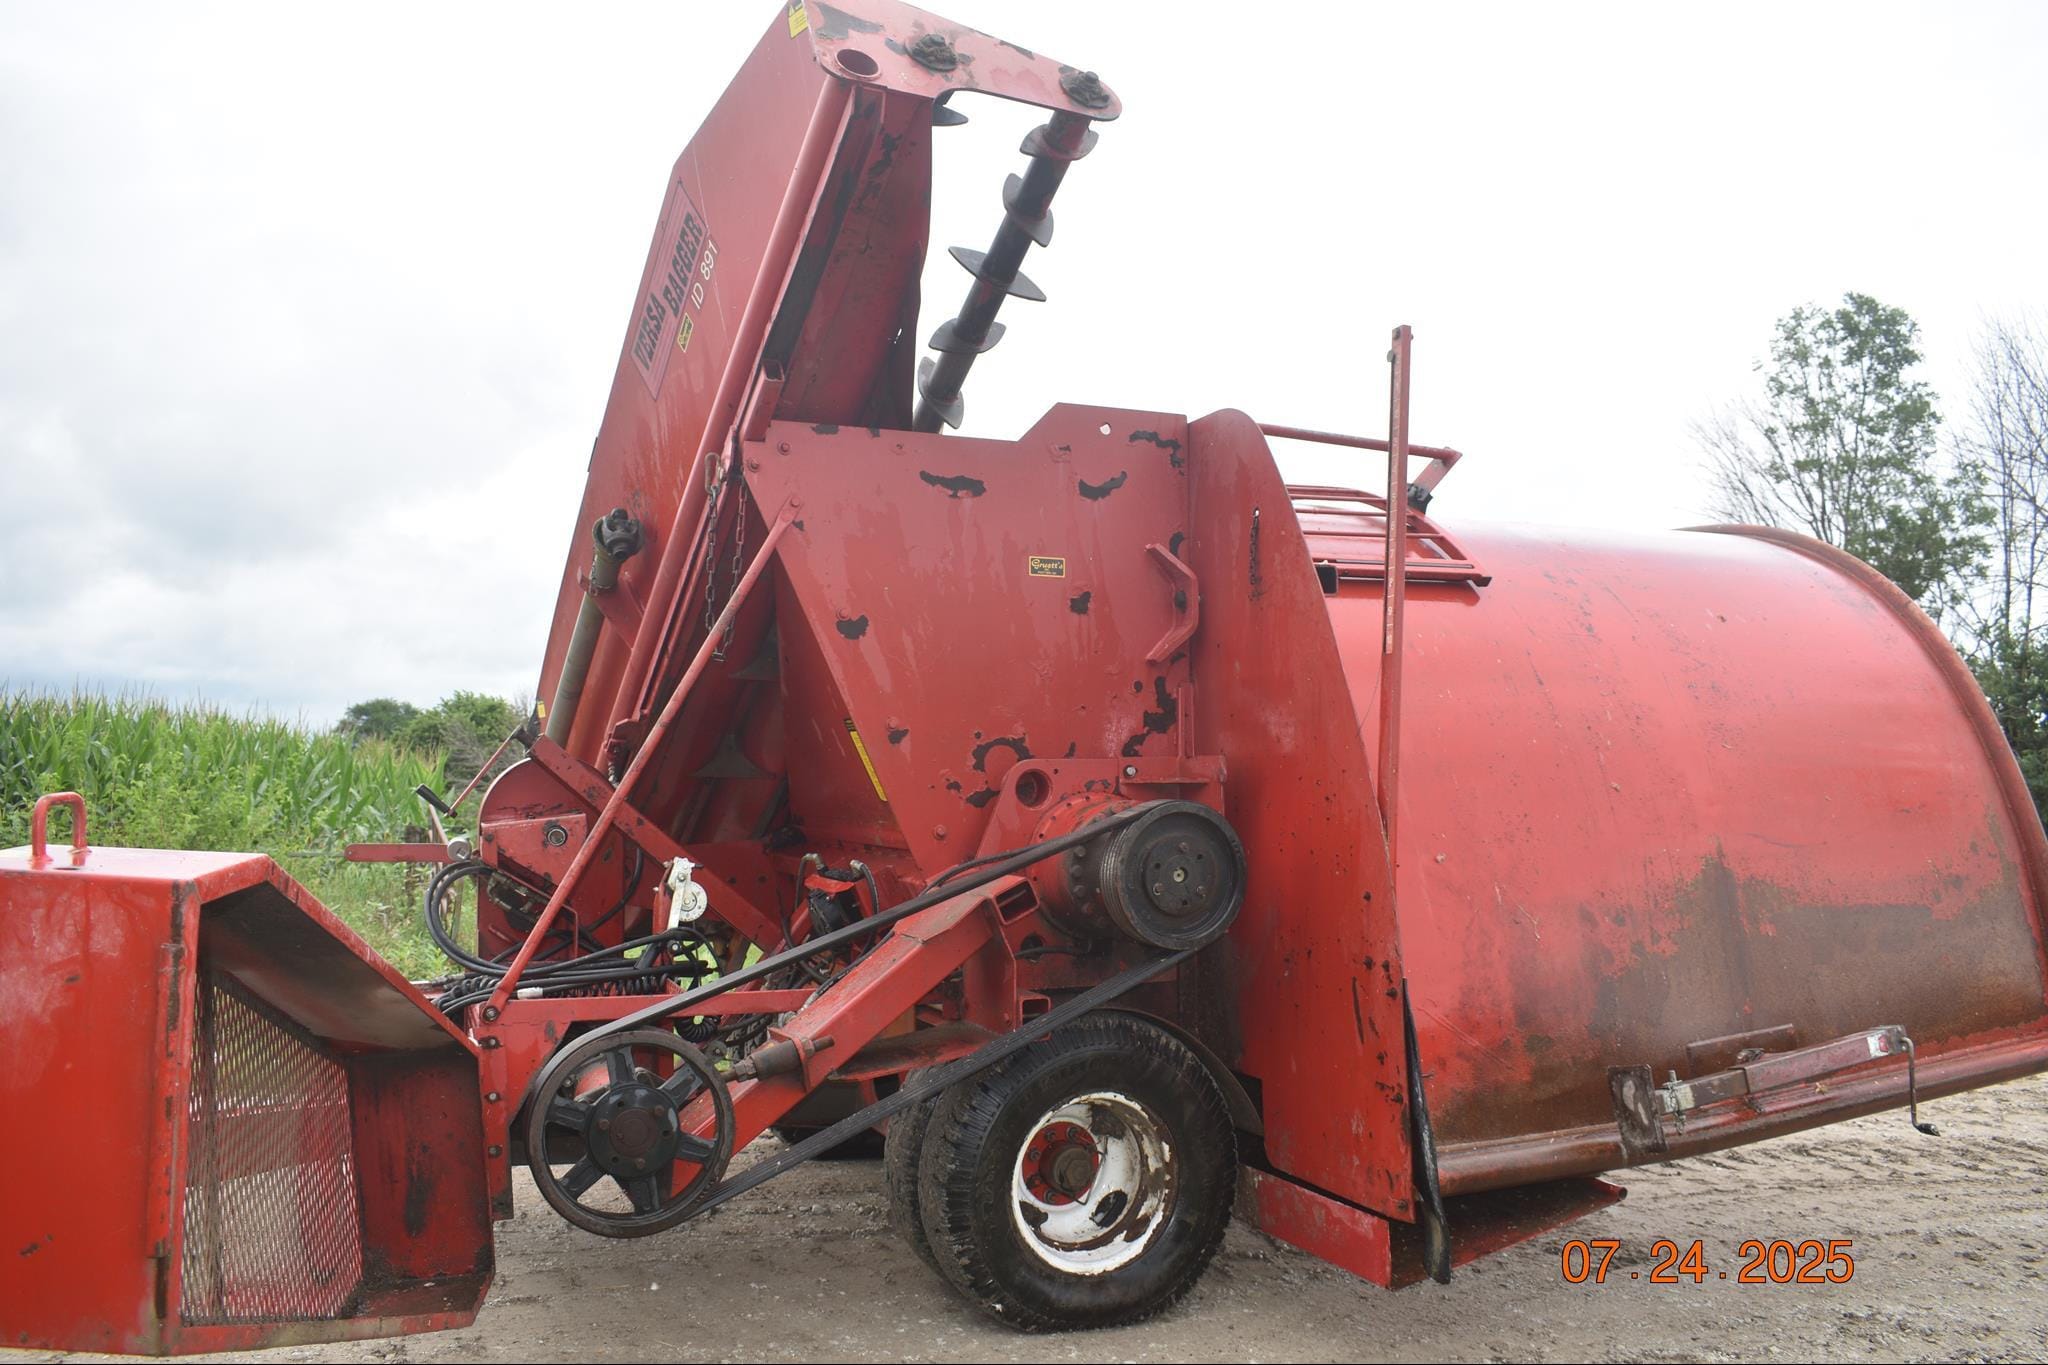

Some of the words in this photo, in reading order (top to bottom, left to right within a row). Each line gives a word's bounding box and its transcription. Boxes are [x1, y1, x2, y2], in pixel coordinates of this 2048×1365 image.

[663, 212, 702, 318] BAGGER
[691, 282, 704, 310] ID
[700, 239, 718, 281] 891
[634, 292, 666, 370] VERSA
